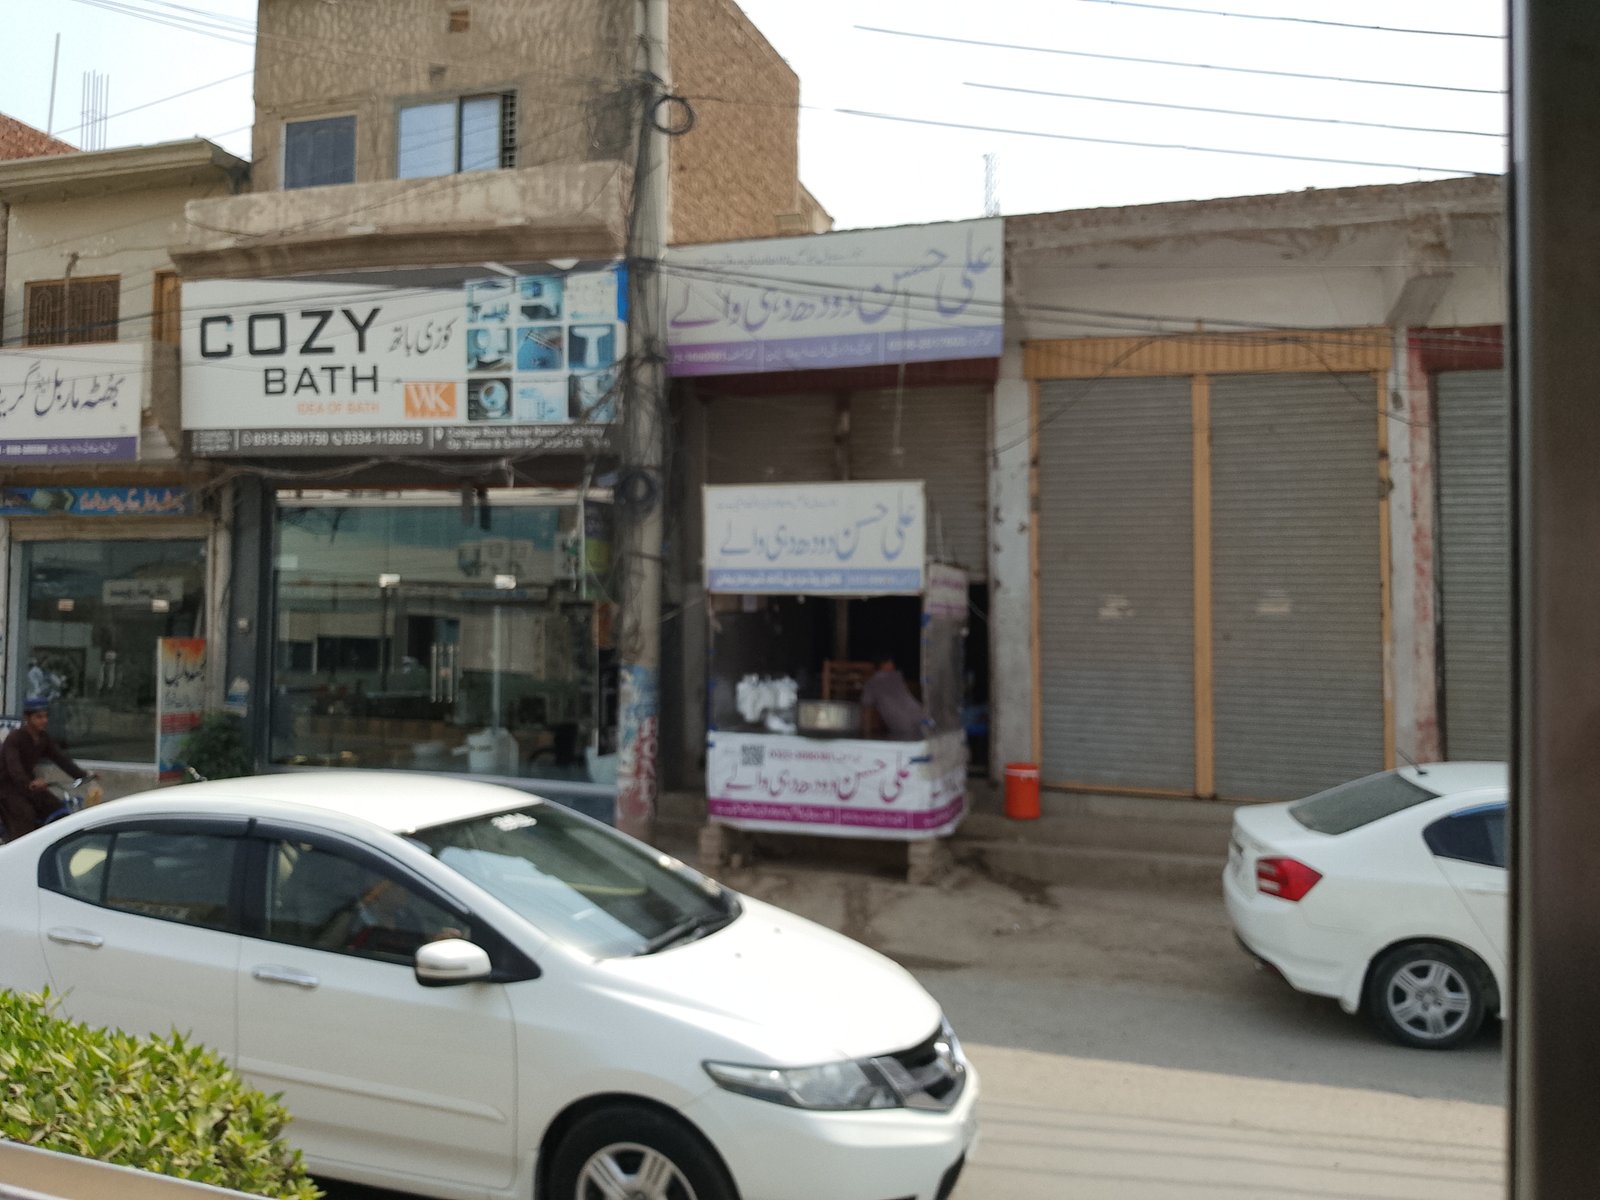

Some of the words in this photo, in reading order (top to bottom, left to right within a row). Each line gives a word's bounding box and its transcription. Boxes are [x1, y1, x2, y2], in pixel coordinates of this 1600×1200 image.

[934, 228, 993, 317] علی
[201, 308, 381, 358] COZY
[416, 316, 459, 354] کوزی
[34, 367, 80, 417] ماربل
[264, 365, 378, 396] BATH
[329, 402, 343, 414] OF
[347, 402, 380, 414] BATH
[879, 750, 911, 804] علی
